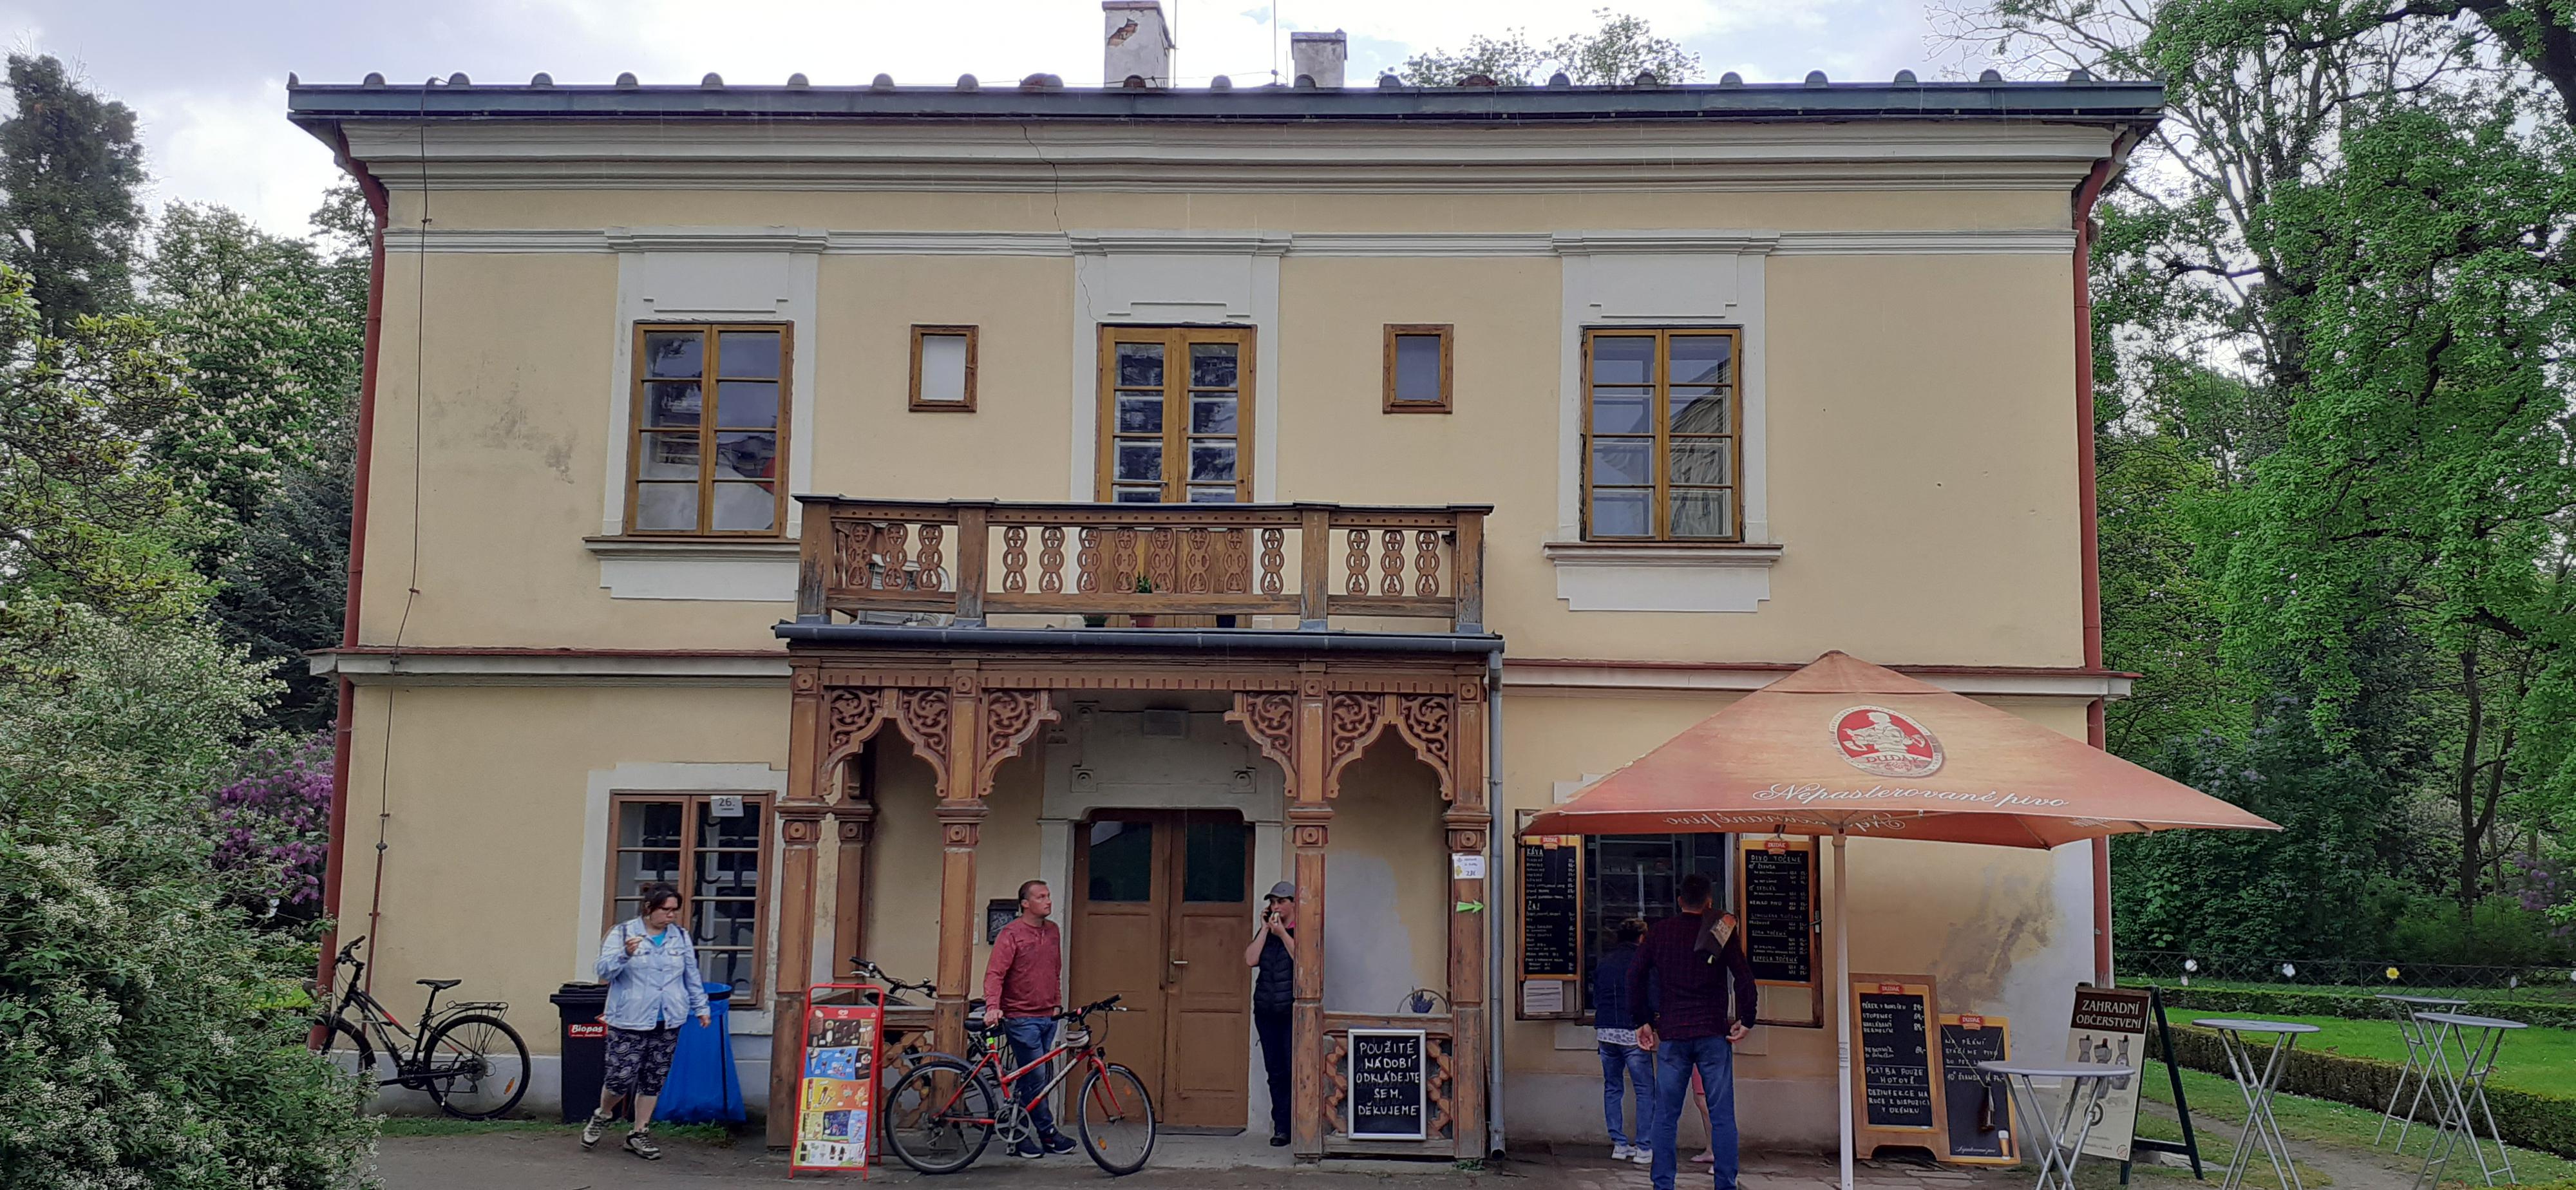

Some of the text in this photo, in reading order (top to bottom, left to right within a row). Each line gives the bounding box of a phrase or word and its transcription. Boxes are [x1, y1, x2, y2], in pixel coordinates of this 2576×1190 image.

[1994, 792, 2069, 808] pivo
[2081, 999, 2141, 1015] ZAHRADNÍ
[2076, 1014, 2143, 1029] OBČERSTVENÍ
[1359, 1039, 1416, 1055] POUŽITÉ
[1365, 1055, 1417, 1070] NÁDOBÍ
[1356, 1070, 1420, 1083] ODKLÁDEJTE
[1866, 1066, 1924, 1076] PLATBA POUZE
[1880, 1075, 1915, 1084] HOTOVĚ
[1373, 1088, 1403, 1099] SEM.
[1358, 1100, 1420, 1116] DĚKUJEME
